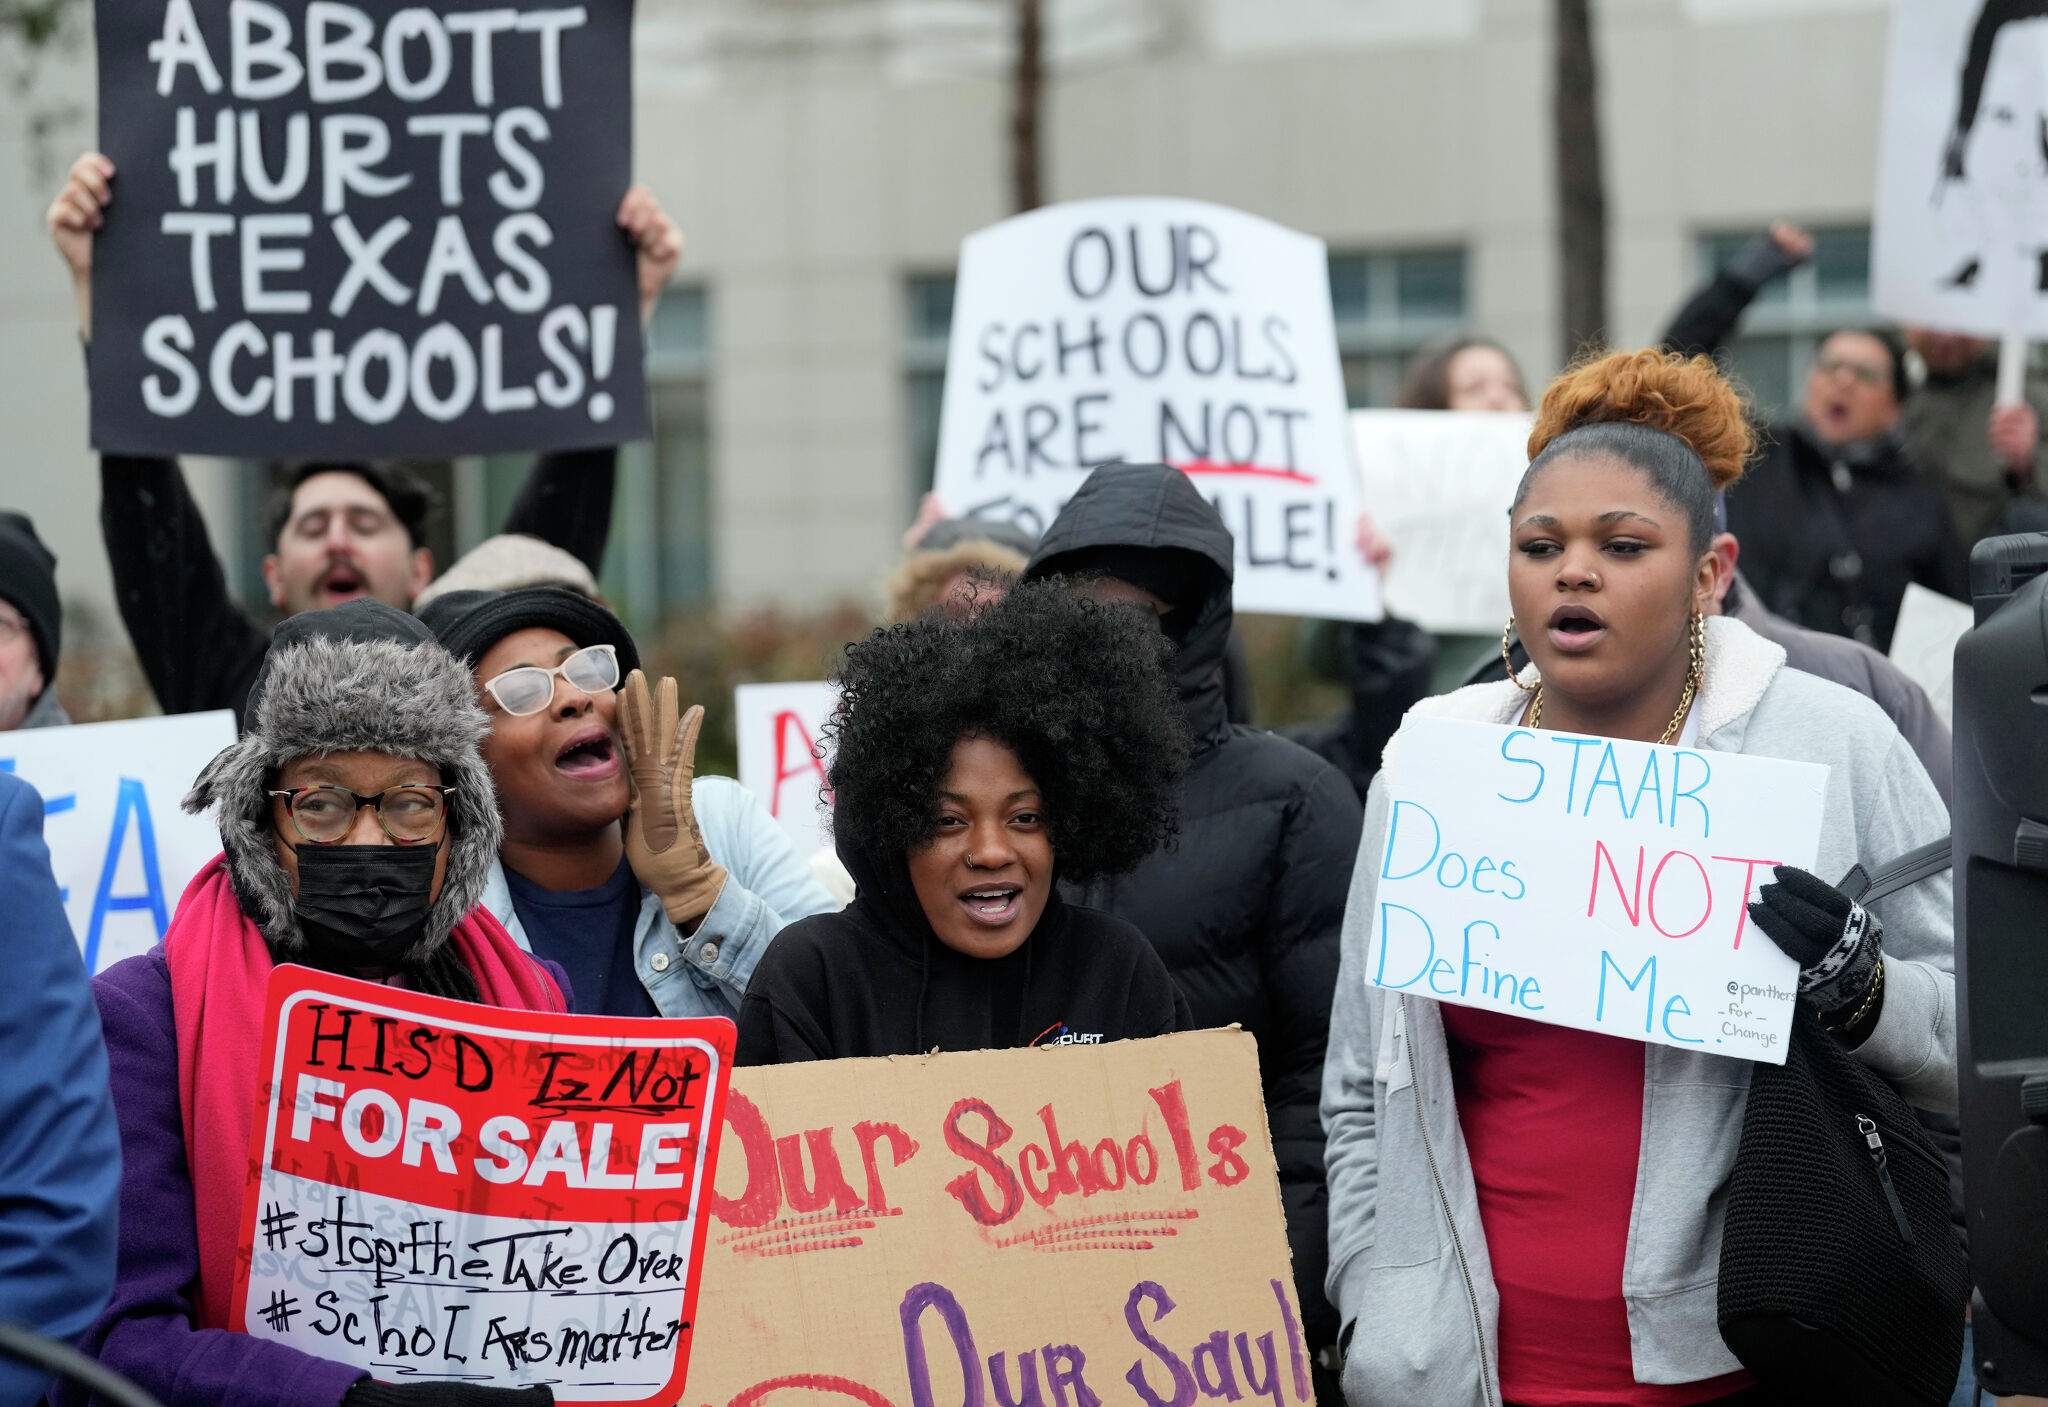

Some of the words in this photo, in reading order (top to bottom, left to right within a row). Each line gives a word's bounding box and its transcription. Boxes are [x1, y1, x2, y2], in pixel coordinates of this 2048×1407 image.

[149, 0, 587, 108] ABBOTT
[169, 106, 551, 214] HURTS
[161, 212, 553, 317] TEXAS
[1066, 222, 1229, 299] OUR
[141, 305, 618, 423] SCHOOLS!
[977, 310, 1298, 393] SCHOOLS
[974, 393, 1128, 479] ARE
[1159, 399, 1309, 474] NOT
[1497, 730, 1712, 838] STAAR
[1381, 800, 1527, 900] Does
[1587, 839, 1784, 950] NOT
[1373, 902, 1545, 1012] Define
[1596, 950, 1722, 1044] Me.
[306, 1003, 494, 1092] HISD
[599, 1048, 701, 1107] Not
[1721, 1021, 1777, 1048] Change
[290, 1072, 462, 1175] FOR
[473, 1114, 690, 1189] SALE
[942, 1077, 1250, 1227] Schools
